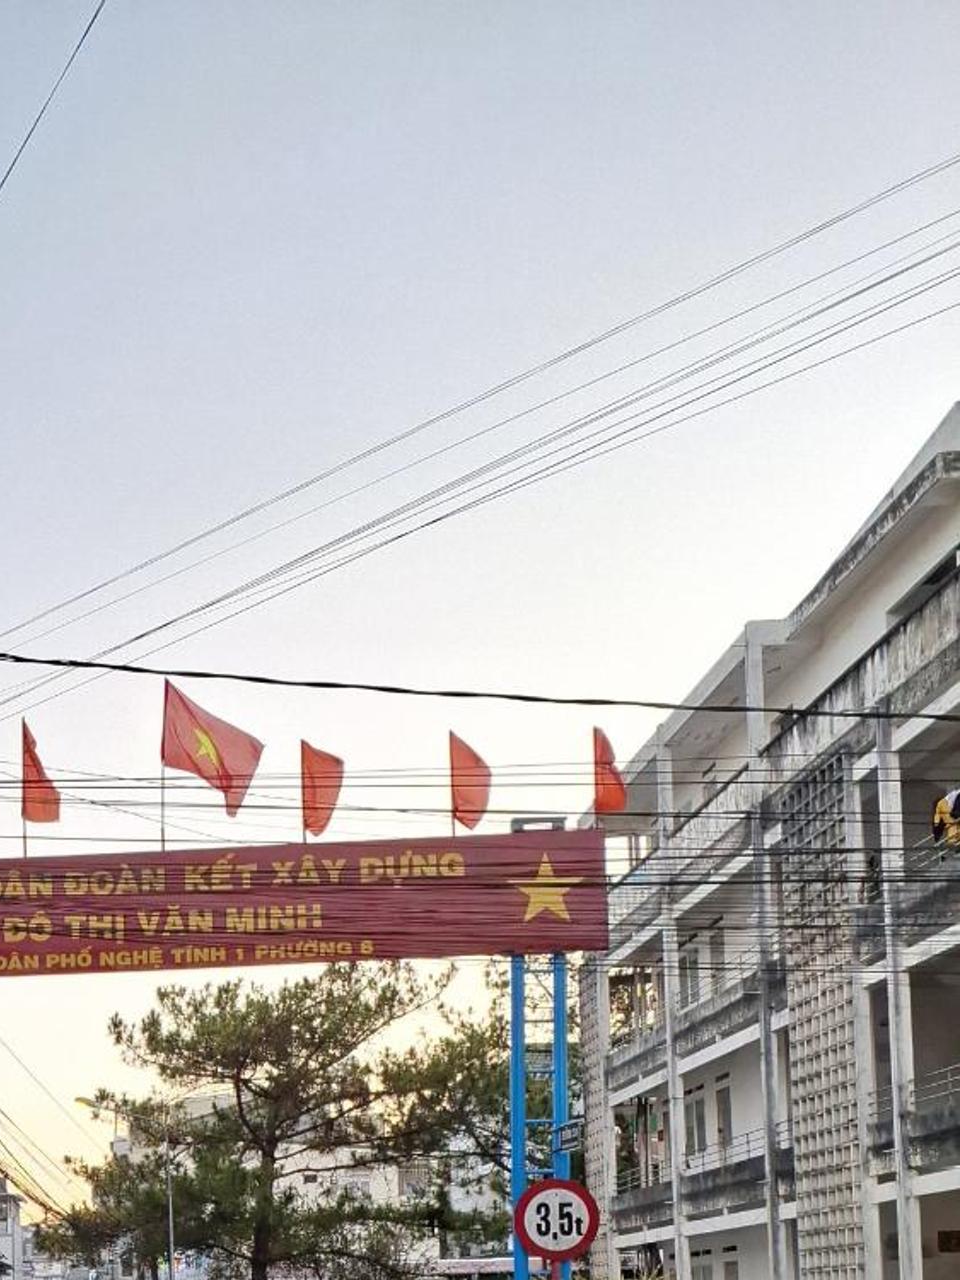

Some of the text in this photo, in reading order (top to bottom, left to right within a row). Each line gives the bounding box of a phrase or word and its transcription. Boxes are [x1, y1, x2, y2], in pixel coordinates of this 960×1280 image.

[271, 854, 346, 888] XÂY
[64, 914, 124, 944] THỊ
[137, 904, 213, 935] VĂN
[226, 903, 323, 933] MINH
[46, 946, 92, 968] PHỐ
[100, 946, 163, 968] NGHỆ
[535, 1202, 584, 1241] 3,5t
